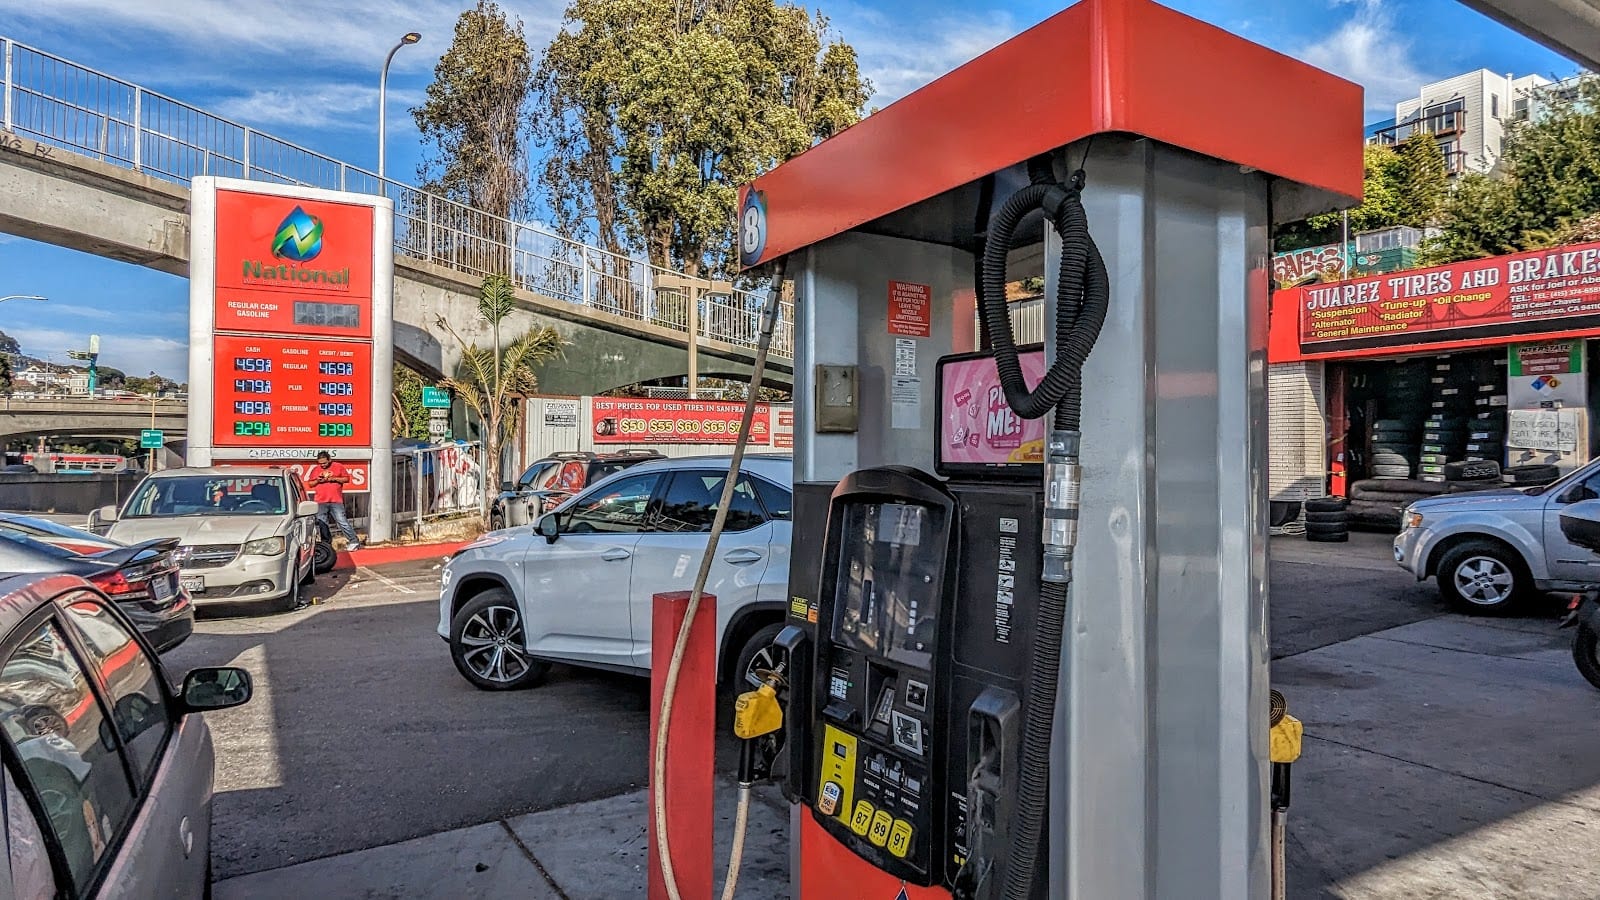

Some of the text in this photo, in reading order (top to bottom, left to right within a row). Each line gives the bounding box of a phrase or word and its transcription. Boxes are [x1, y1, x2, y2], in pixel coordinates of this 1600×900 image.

[744, 206, 759, 254] 8
[243, 260, 349, 284] National
[1307, 280, 1380, 310] JUAREZ
[1389, 271, 1453, 299] TIRES
[1460, 268, 1500, 290] AND
[1510, 284, 1530, 293] ASK
[1531, 283, 1545, 291] for
[1547, 280, 1566, 289] Joel
[228, 301, 259, 309] REGULAR
[1384, 299, 1426, 311] Tune-up
[1437, 291, 1492, 305] Oil Change
[236, 310, 270, 318] GASOLINE
[1314, 306, 1368, 318] Suspension
[1384, 309, 1424, 320] Radiator
[1314, 318, 1357, 329] Alternator
[1317, 322, 1408, 338] General Maintenance
[595, 402, 614, 410] BEST
[617, 402, 643, 410] PRICES
[646, 403, 660, 411] FOR
[662, 403, 682, 411] USED
[684, 404, 704, 412] TIRES
[706, 404, 715, 412] IN
[620, 419, 647, 433] $50
[649, 420, 674, 433] $55
[676, 420, 701, 433] $60
[703, 421, 726, 434] $65
[986, 406, 1021, 440] ME!
[855, 811, 868, 826] 87
[874, 822, 886, 837] 89
[894, 832, 906, 849] 91
